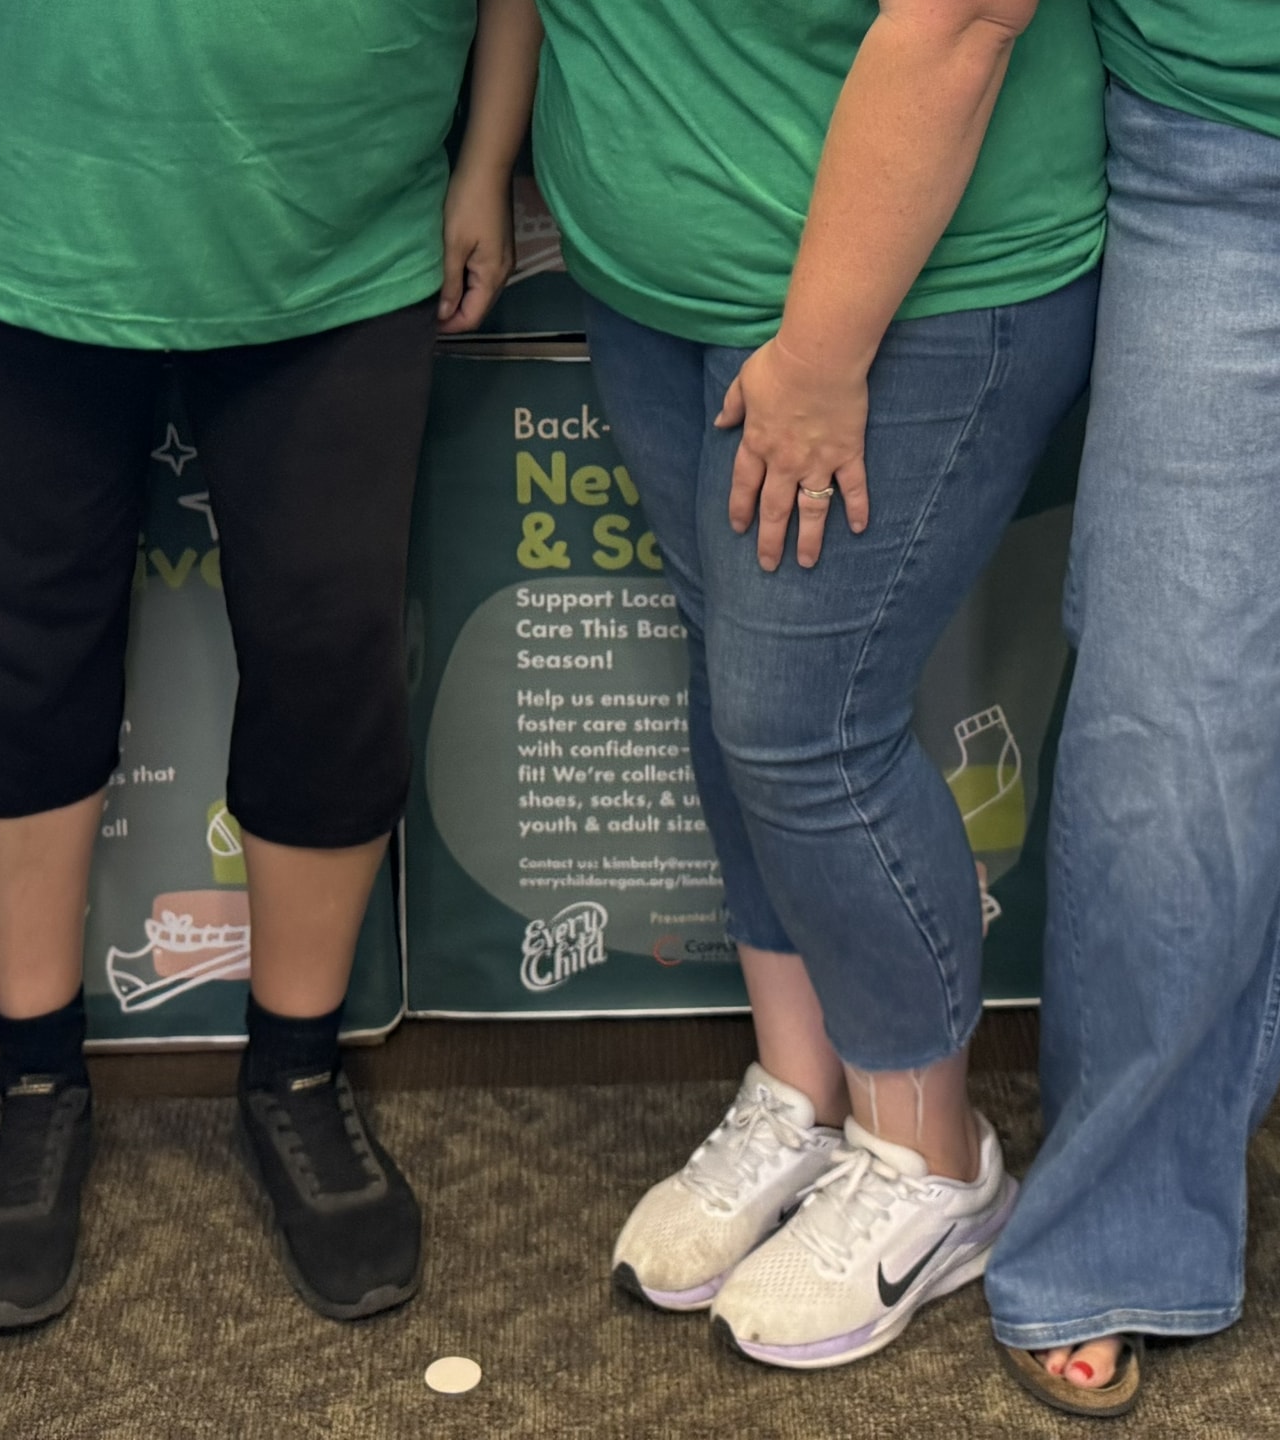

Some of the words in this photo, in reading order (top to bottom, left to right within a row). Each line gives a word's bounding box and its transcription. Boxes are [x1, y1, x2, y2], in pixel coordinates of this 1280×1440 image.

[517, 511, 571, 570] &
[517, 589, 614, 613] Support
[516, 620, 573, 639] Care
[580, 619, 629, 638] This
[517, 650, 614, 670] Season!
[517, 689, 564, 710] Help
[571, 694, 594, 707] us
[600, 693, 670, 707] ensure
[517, 715, 577, 732] foster
[583, 719, 627, 732] care
[634, 717, 688, 732] starts
[518, 740, 563, 757] with
[133, 765, 175, 783] that
[518, 765, 545, 783] fit!
[519, 790, 582, 810] shoes,
[590, 791, 652, 810] socks,
[659, 792, 675, 807] &
[102, 818, 128, 837] all
[519, 816, 577, 837] youth
[585, 816, 601, 833] &
[608, 815, 660, 833] adult
[520, 858, 573, 870] Contact
[650, 911, 718, 924] Presented
[522, 901, 608, 956] Every
[520, 932, 608, 991] Child
